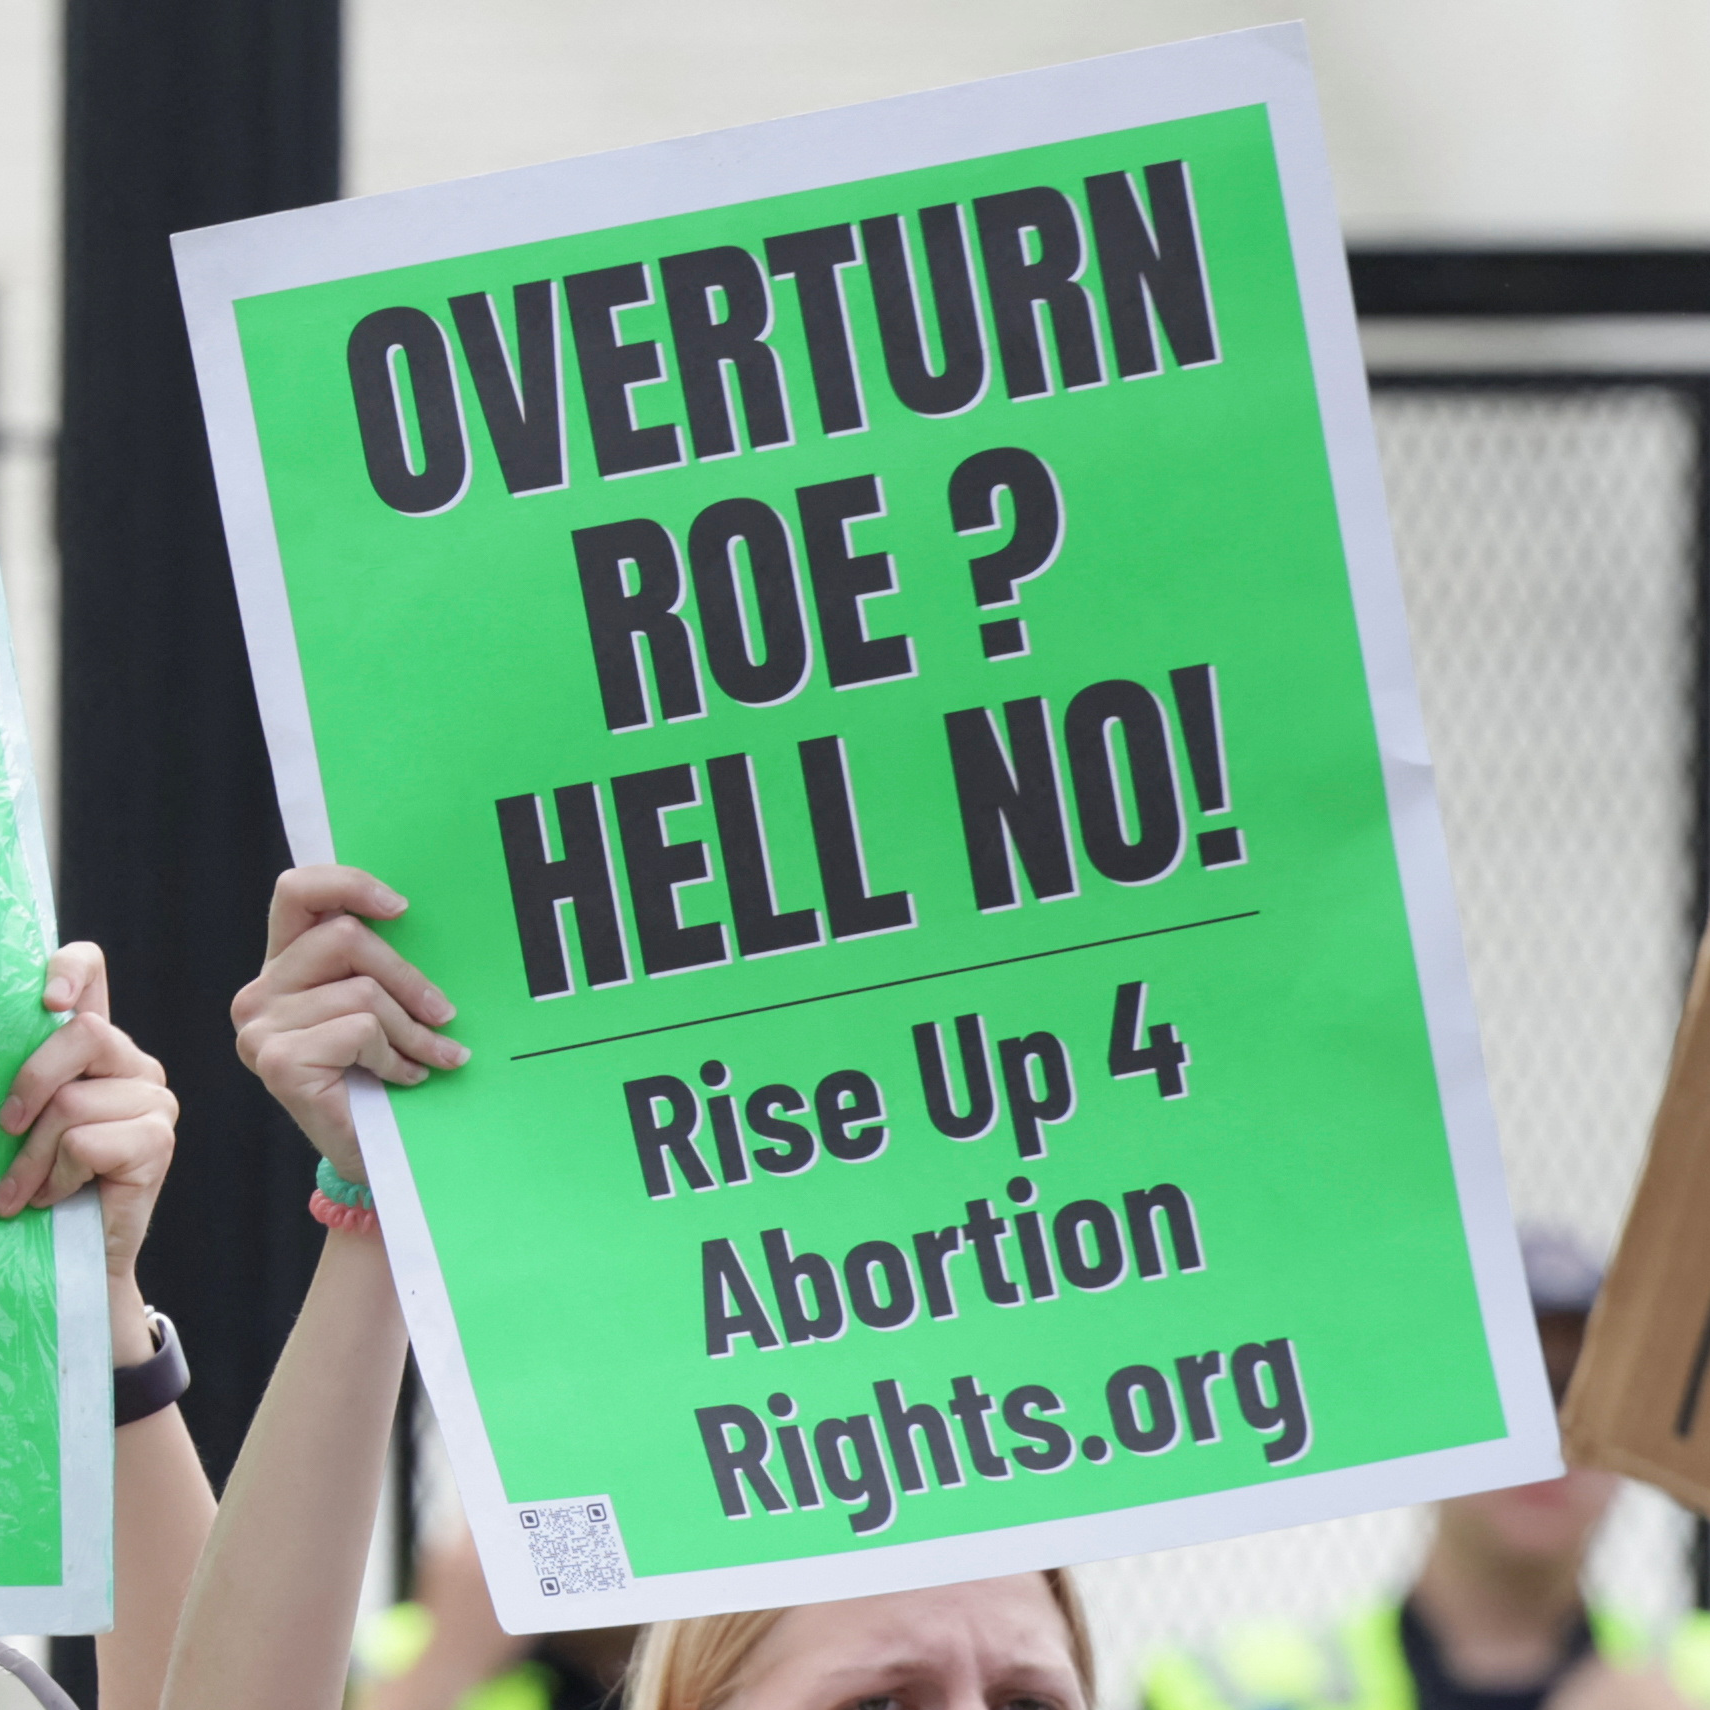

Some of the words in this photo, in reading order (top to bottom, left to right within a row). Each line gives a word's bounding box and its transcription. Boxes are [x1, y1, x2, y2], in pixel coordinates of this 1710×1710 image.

[345, 159, 1223, 516] OVERTURN
[571, 473, 919, 734] ROE
[947, 445, 1066, 660] ?
[494, 733, 918, 1000] HELL
[943, 662, 1248, 912] NO!
[623, 1058, 887, 1200] Rise
[911, 1012, 1077, 1159] Up
[1106, 980, 1191, 1100] 4
[699, 1175, 1205, 1358] Abortion
[693, 1336, 1315, 1536] Rights.org
